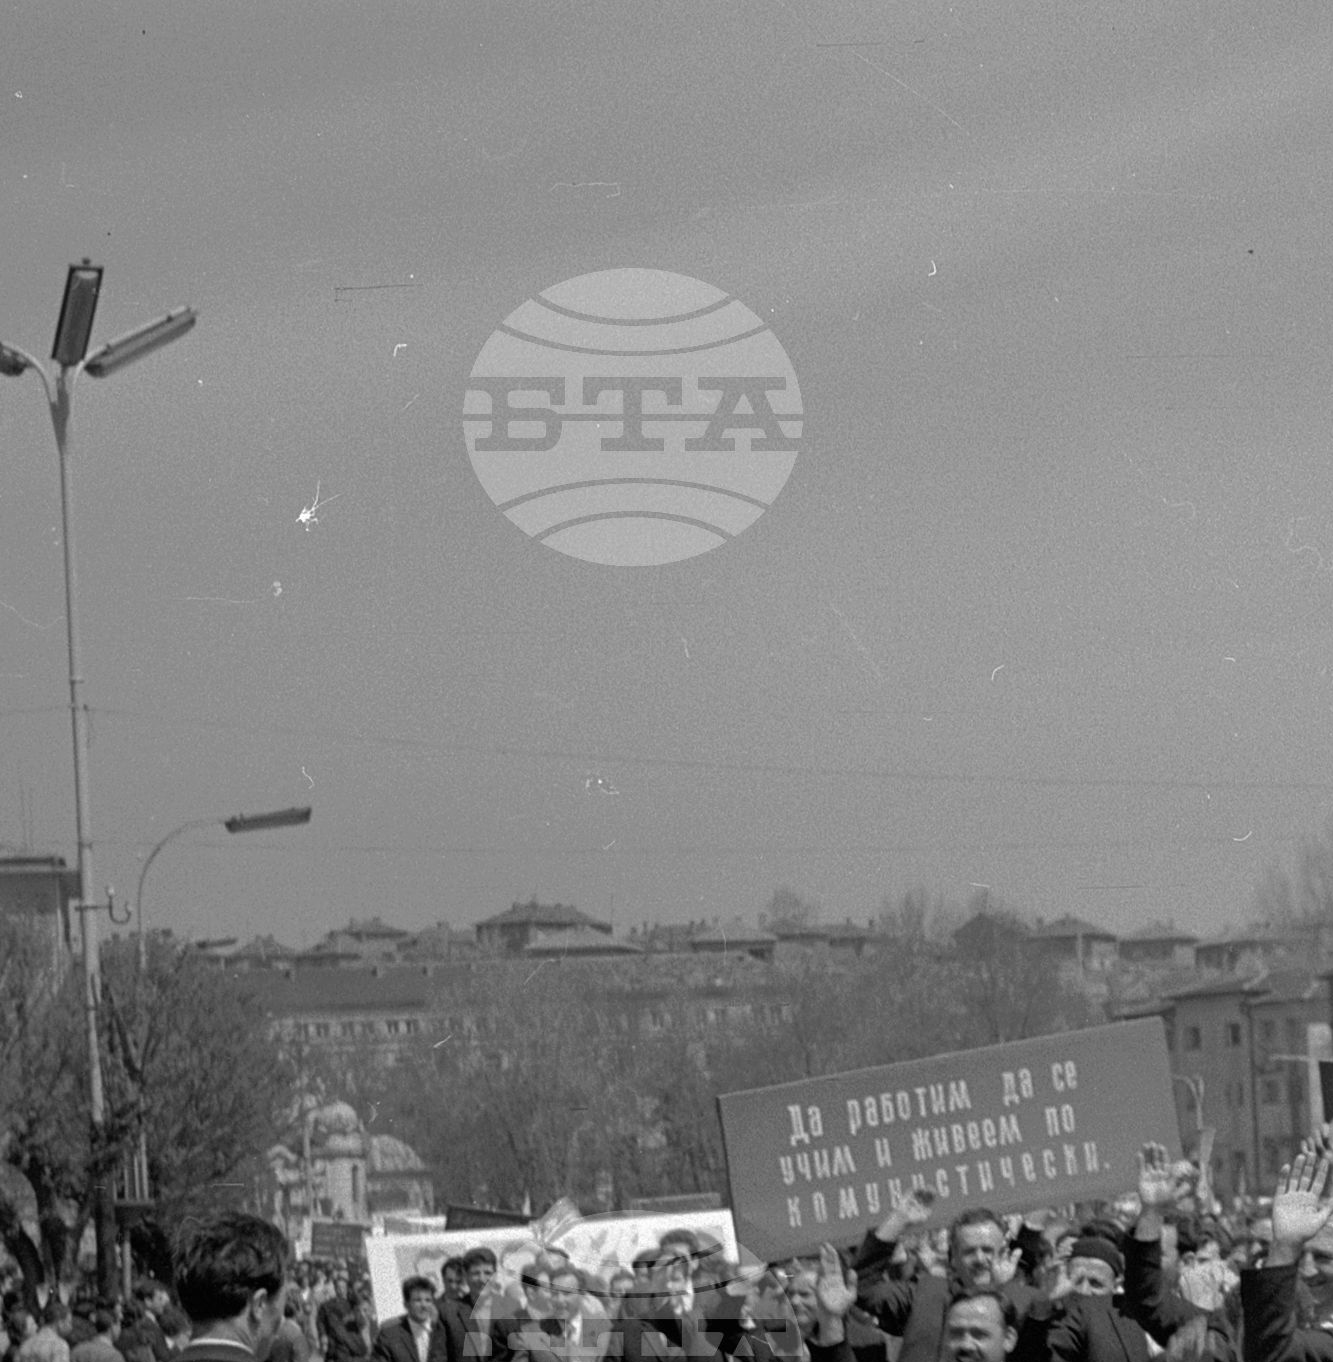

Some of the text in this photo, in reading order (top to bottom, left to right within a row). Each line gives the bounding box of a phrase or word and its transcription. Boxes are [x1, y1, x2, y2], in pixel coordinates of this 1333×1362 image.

[779, 1103, 1076, 1186] учим и живеем по
[786, 1059, 1078, 1147] Да работим да се
